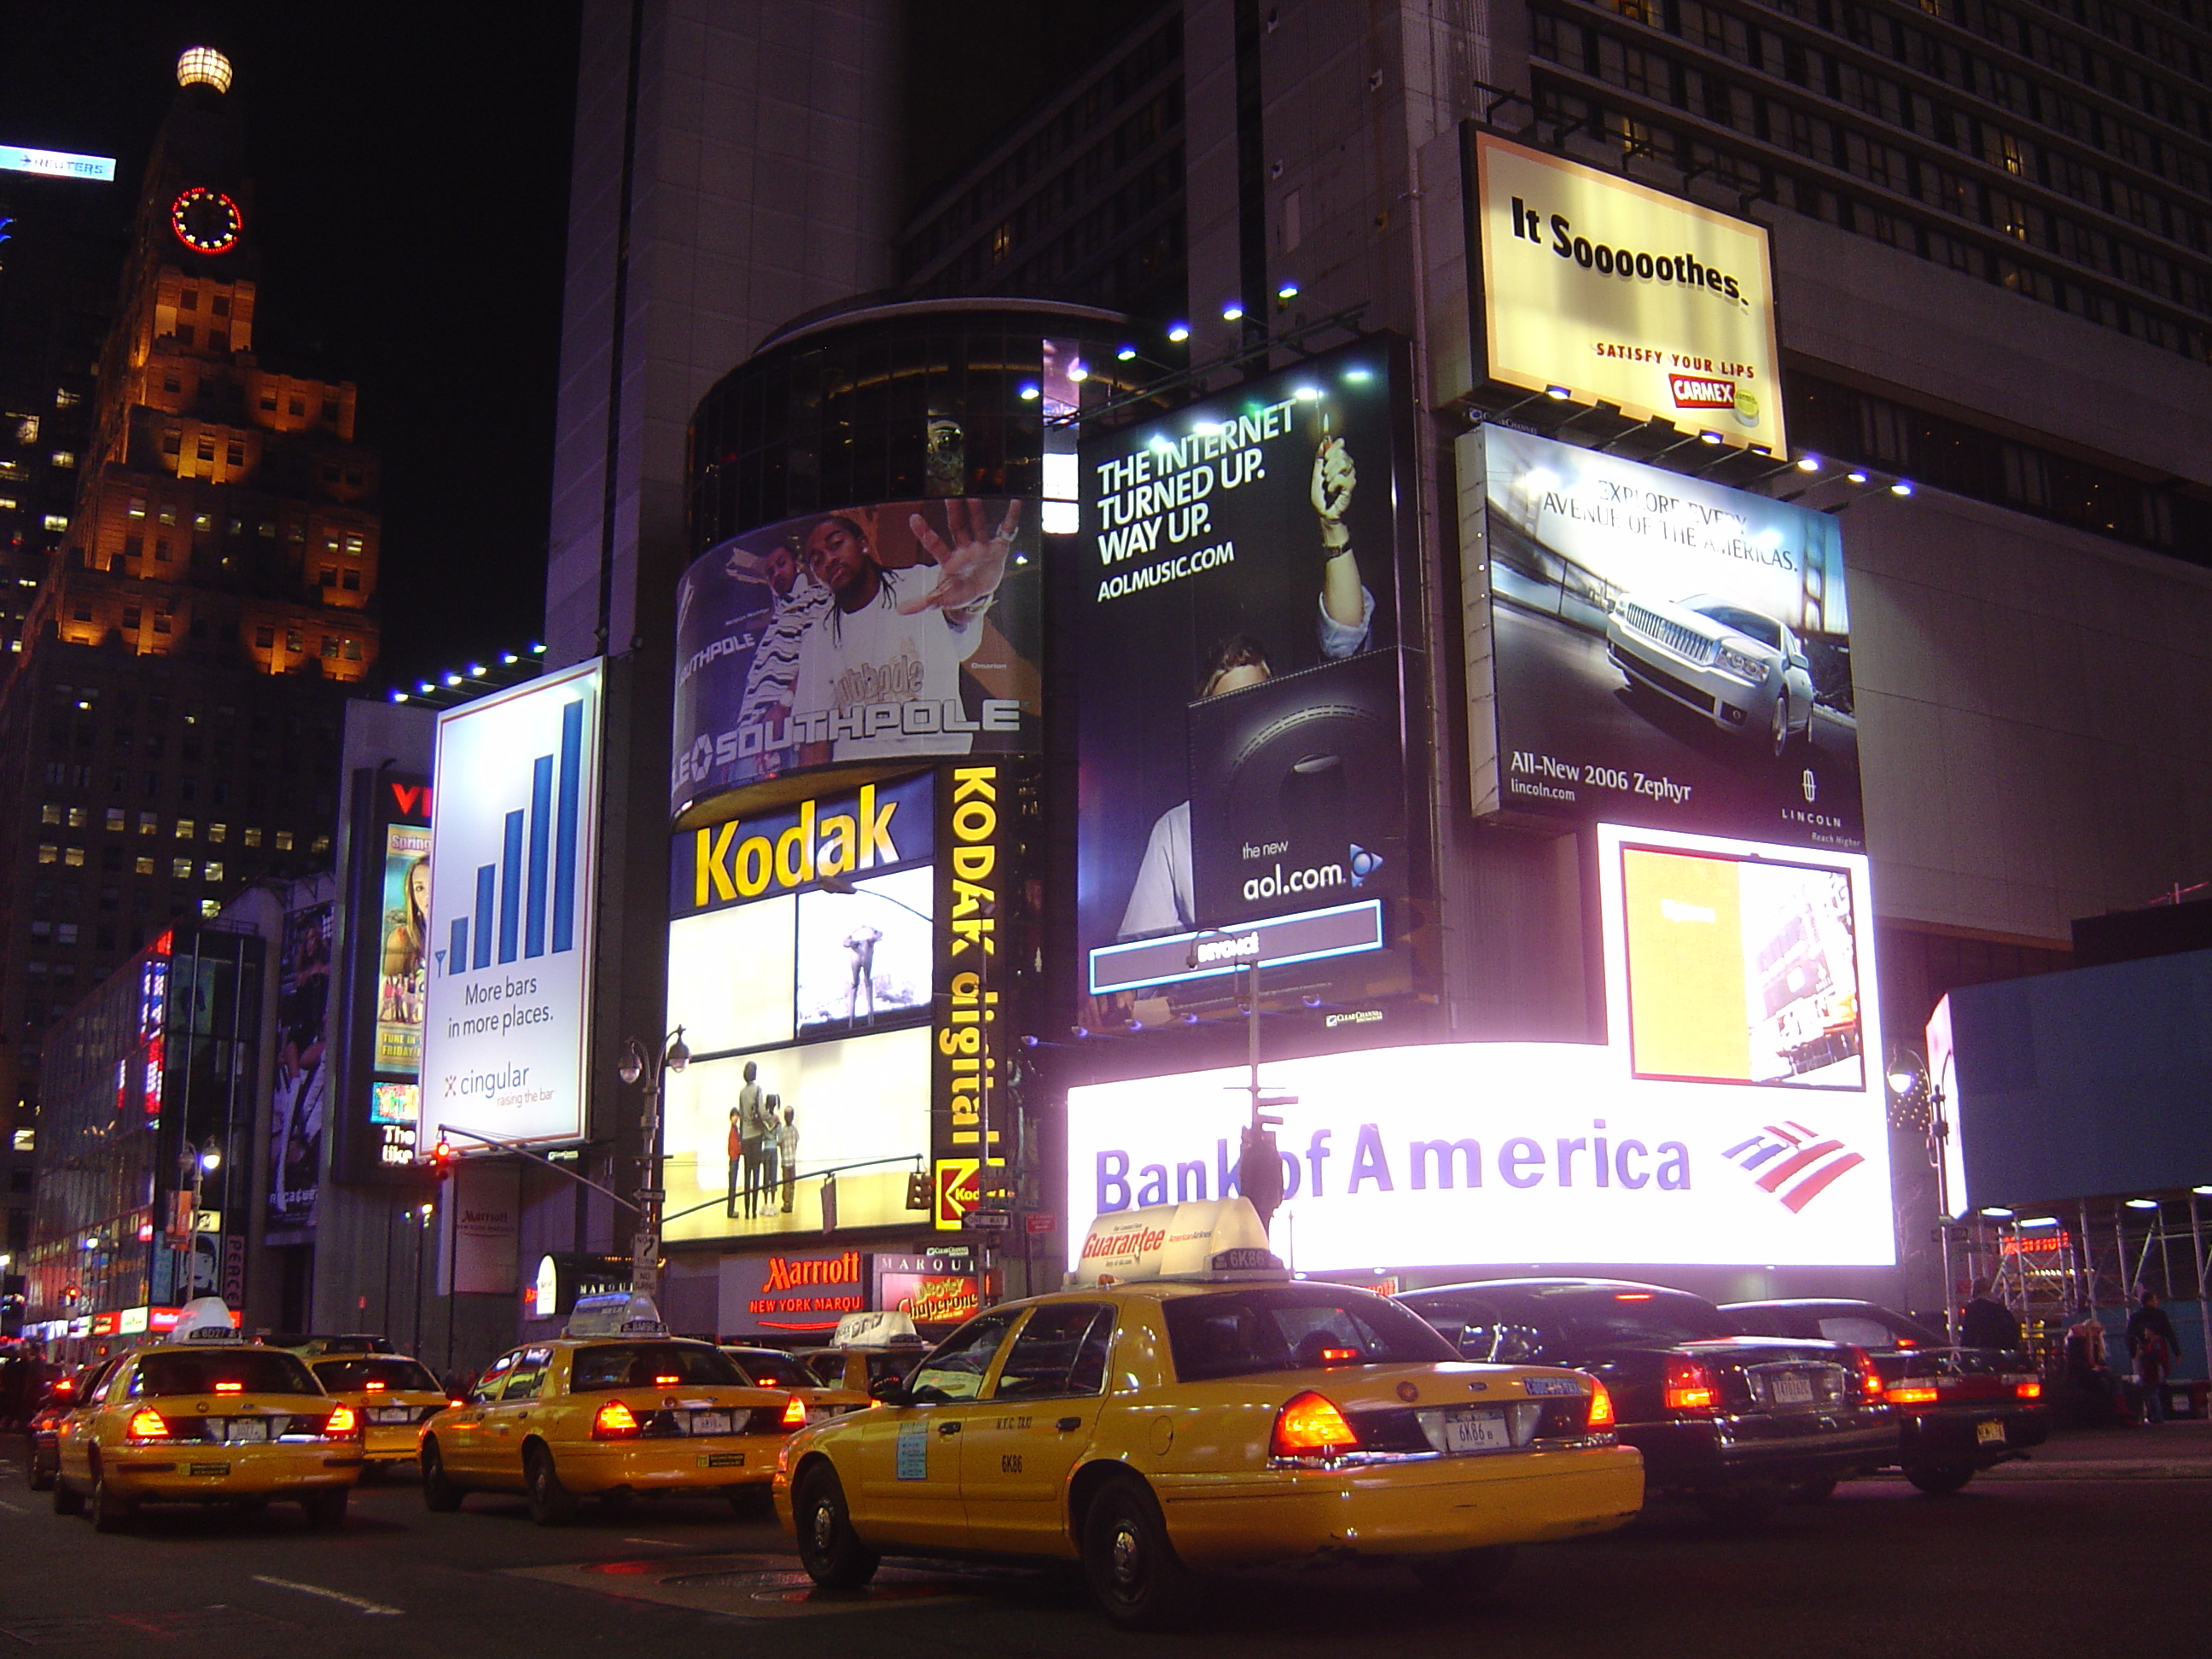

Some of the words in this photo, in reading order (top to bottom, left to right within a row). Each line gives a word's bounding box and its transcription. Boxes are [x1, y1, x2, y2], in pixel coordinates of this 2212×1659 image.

[1511, 196, 1541, 243] It
[1551, 213, 1749, 306] Sooooothes.
[1597, 343, 1662, 364] SATISFY
[1672, 353, 1714, 373] YOUR
[1721, 362, 1755, 379] LIPS
[1674, 378, 1733, 402] CARMEX
[1097, 450, 1150, 495] THE
[1157, 399, 1297, 477] INTERNET
[1097, 467, 1214, 530] TURNED
[1220, 447, 1266, 490] UP.
[1598, 480, 1679, 514] EXPLORE
[1097, 516, 1164, 565] WAY
[1168, 503, 1212, 544] UP.
[1543, 492, 1621, 527] AVENUE
[1628, 514, 1651, 535] OF
[1660, 521, 1697, 547] THE
[1703, 536, 1798, 573] AMERICAS.
[1097, 541, 1235, 602] AOLMUSIC.COM
[715, 699, 1021, 767] SOUTHPOLE
[1511, 751, 1580, 781] All-New
[1585, 765, 1628, 791] 2006
[1633, 773, 1691, 804] Zephyr
[1511, 779, 1575, 801] lincoln.com
[1782, 809, 1842, 828] LINCOLN
[391, 834, 431, 852] Spring
[695, 783, 901, 907] Kodak
[1243, 841, 1260, 860] the
[1263, 840, 1289, 857] new
[1811, 832, 1832, 844] Reach
[1834, 835, 1860, 847] Higher
[952, 766, 997, 956] KODAK
[1243, 864, 1342, 900] aol.com
[465, 982, 502, 1006] More
[505, 975, 538, 998] bars
[448, 1017, 460, 1039] in
[463, 1014, 499, 1036] more
[503, 1004, 554, 1036] places.
[381, 1045, 414, 1057] FRIDAY
[383, 1033, 404, 1045] TUNE
[939, 972, 999, 1144] digital
[461, 1062, 530, 1099] cingular
[497, 1094, 523, 1109] raising
[525, 1090, 538, 1104] the
[539, 1088, 555, 1101] bar
[382, 1125, 416, 1145] The
[1096, 1138, 1243, 1214] Bank
[1347, 1120, 1692, 1193] America
[1082, 1226, 1165, 1259] Guarantee
[1230, 1250, 1265, 1268] 6K86
[762, 1251, 860, 1293] Marriott
[749, 1300, 776, 1313] NEW
[778, 1298, 811, 1312] YORK
[896, 1293, 979, 1320] Chaperone
[1017, 1416, 1033, 1429] TAXI
[1458, 1423, 1485, 1441] 6K86
[1001, 1455, 1023, 1473] 6K86
